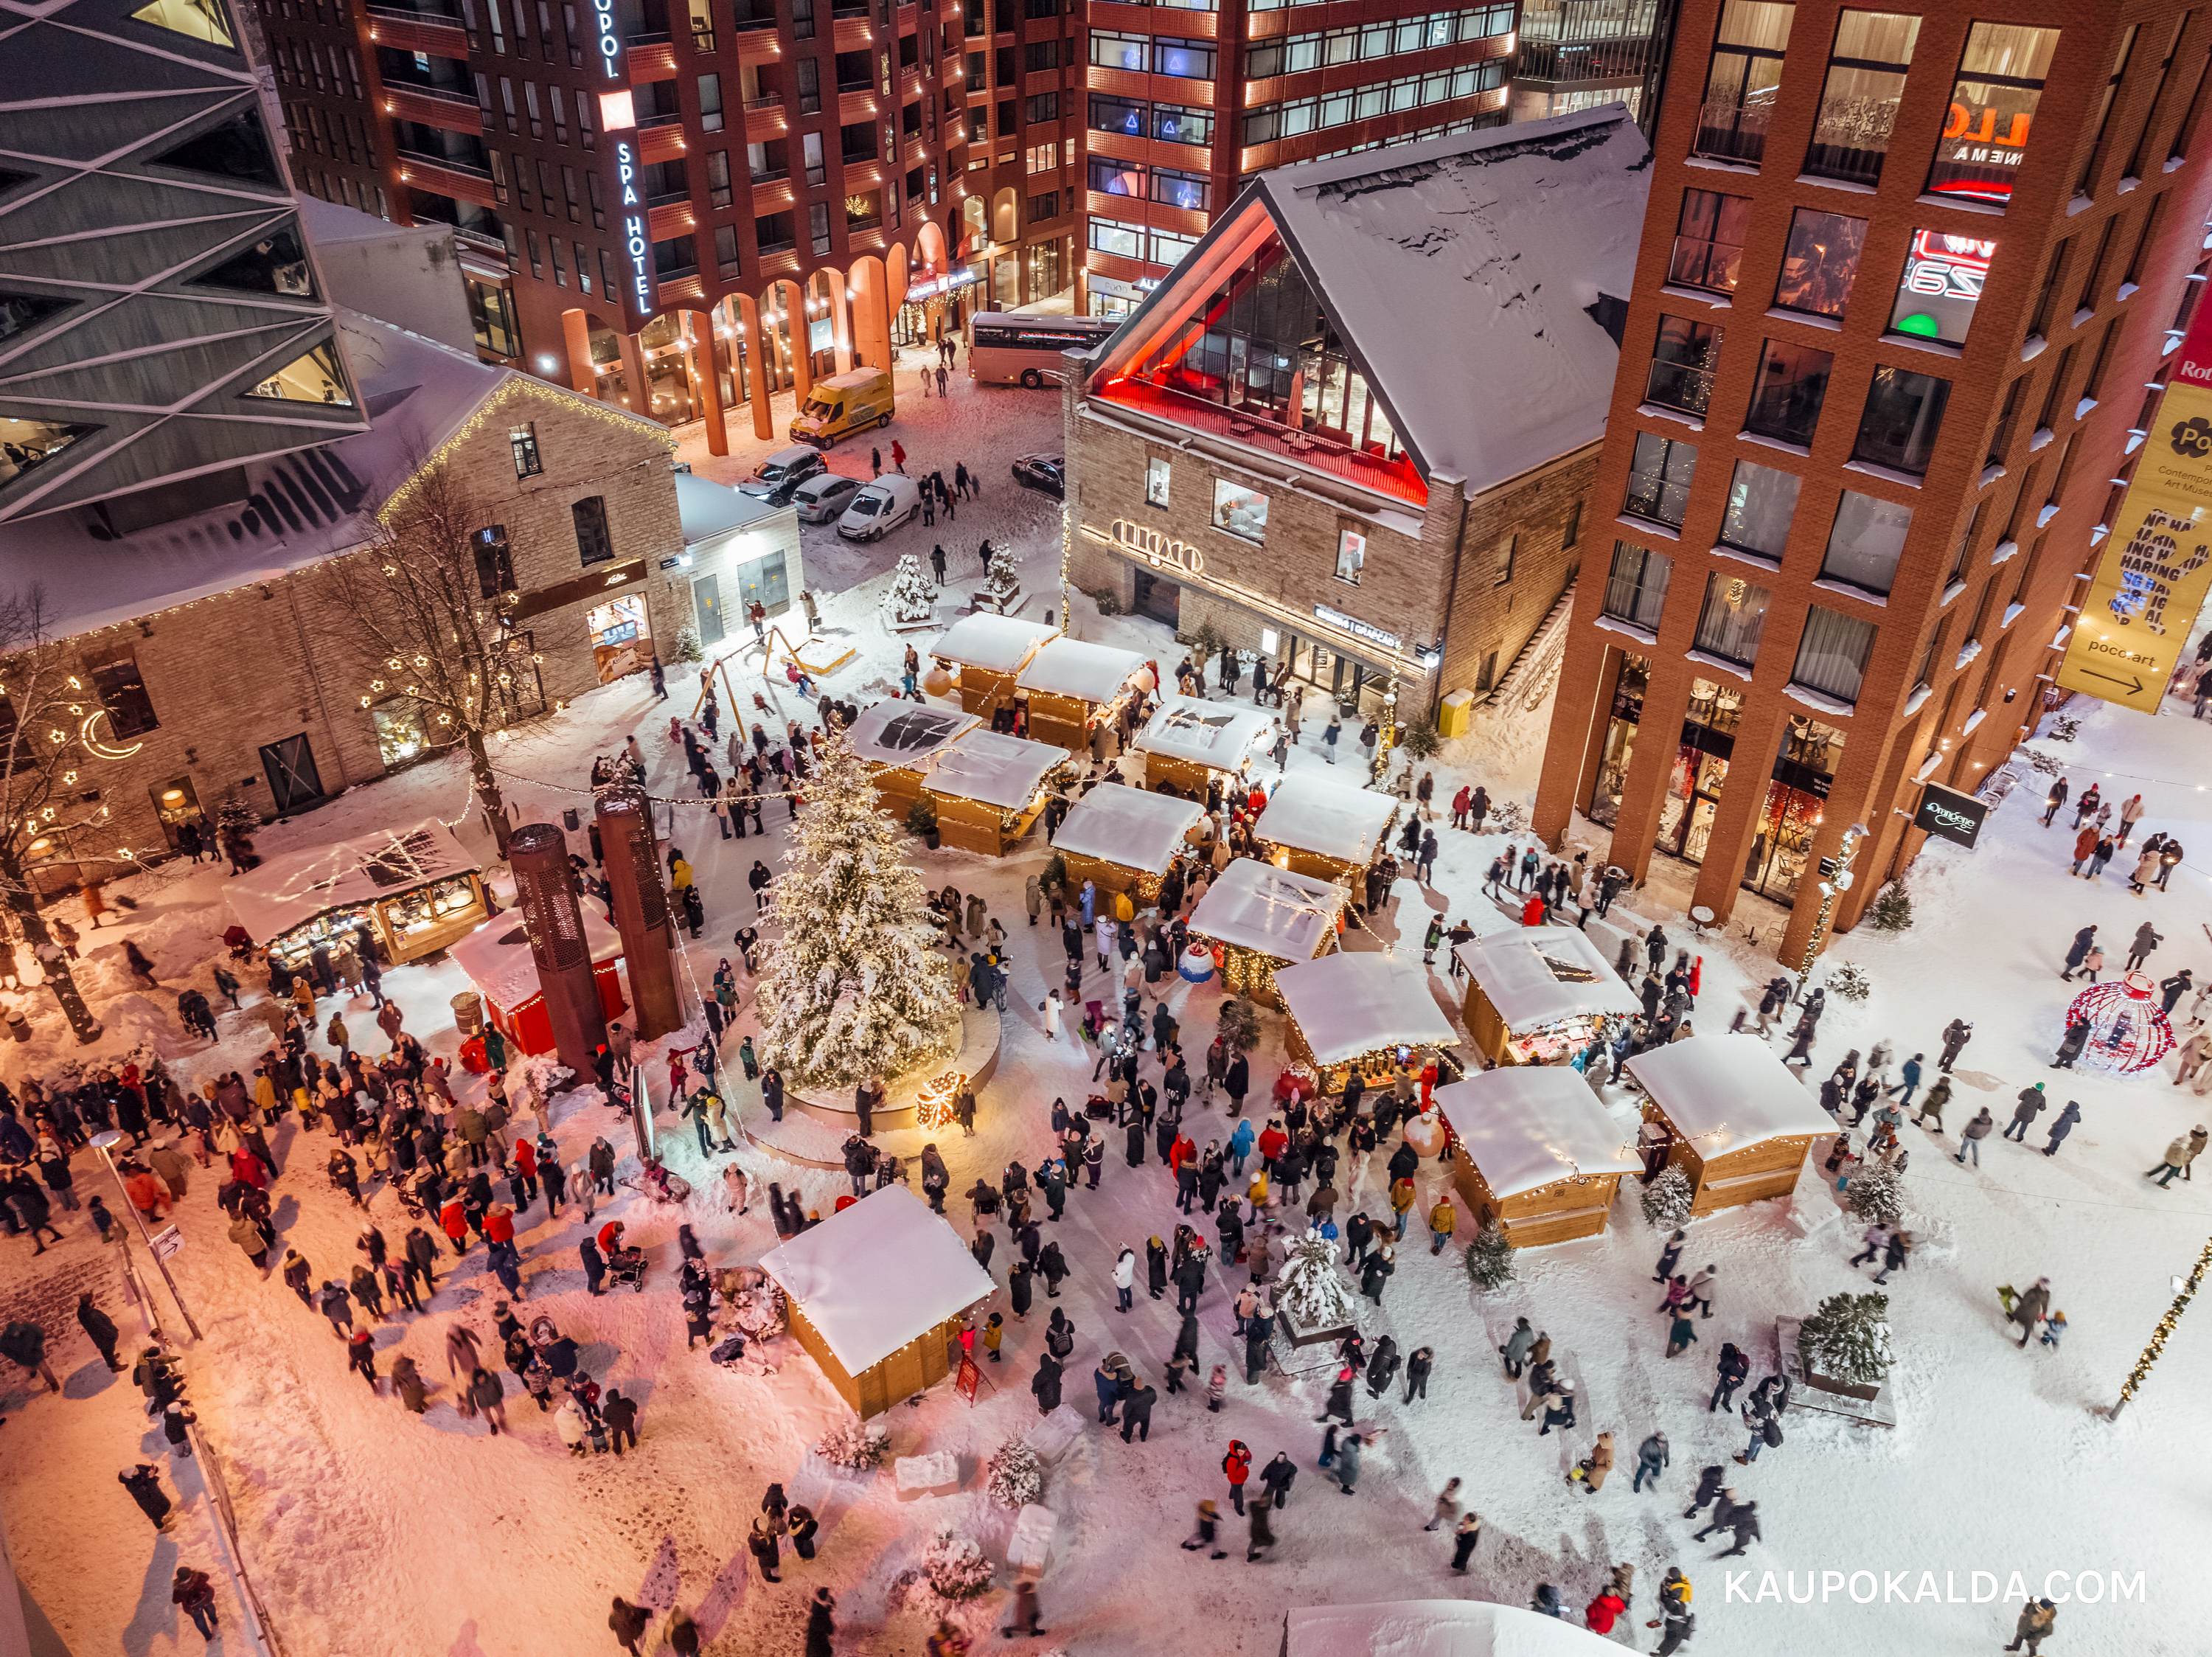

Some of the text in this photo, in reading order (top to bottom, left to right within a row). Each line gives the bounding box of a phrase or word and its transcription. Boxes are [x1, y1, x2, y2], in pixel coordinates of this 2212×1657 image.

[619, 143, 637, 205] SPA
[627, 216, 651, 314] HOTEL
[2164, 479, 2180, 489] Art
[2120, 555, 2180, 582] HARING
